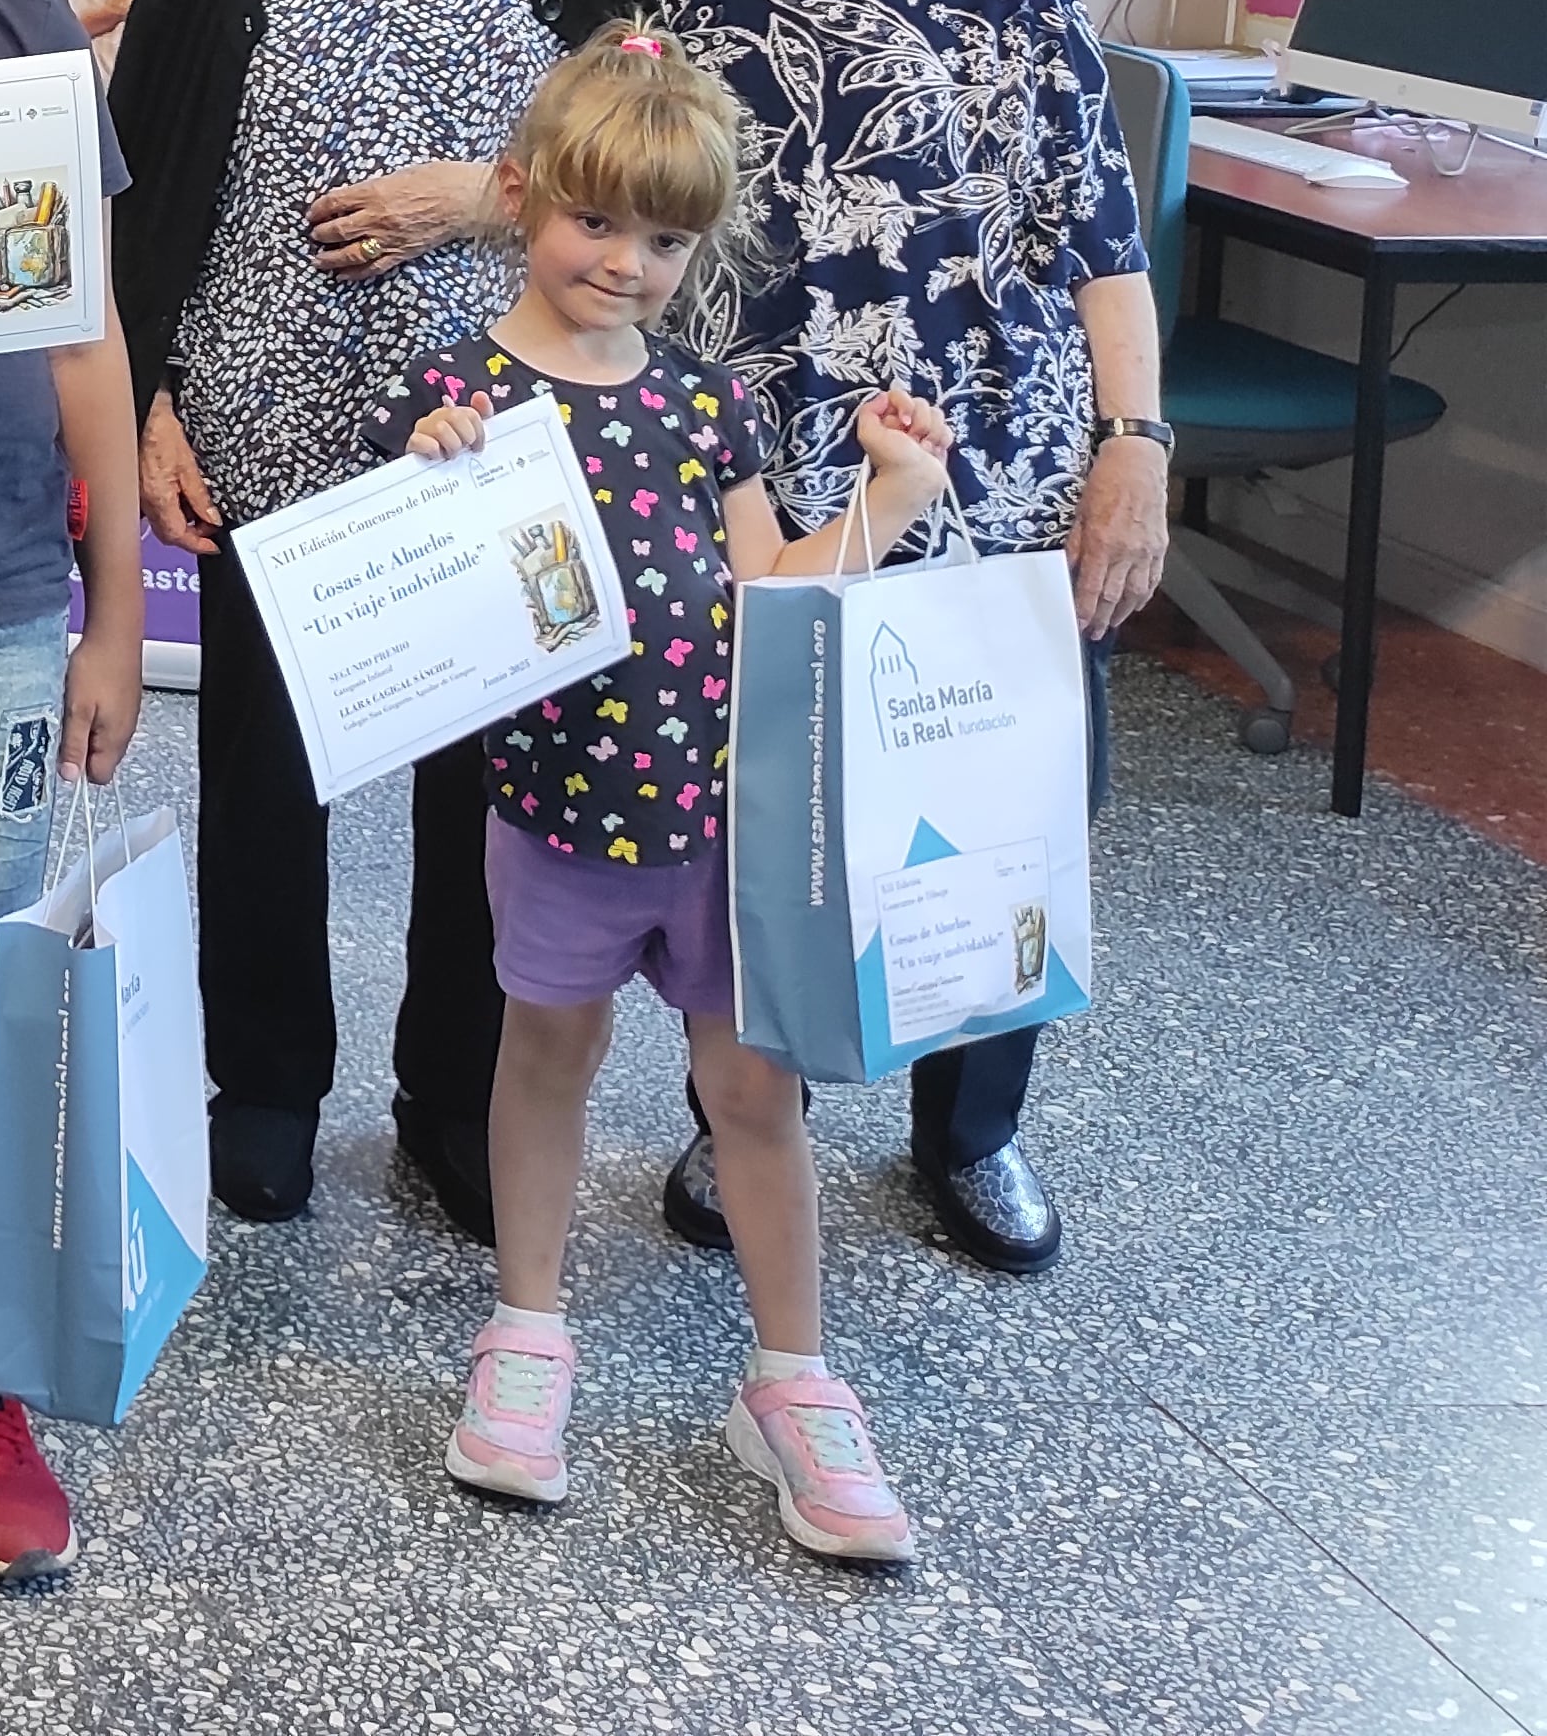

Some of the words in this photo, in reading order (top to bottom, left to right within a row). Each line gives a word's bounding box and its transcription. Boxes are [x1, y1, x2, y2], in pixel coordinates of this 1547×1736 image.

[271, 547, 297, 569] XII
[298, 530, 347, 556] Edición
[347, 504, 403, 535] Concurso
[405, 494, 419, 511] de
[419, 477, 460, 503] Dibujo
[313, 571, 362, 603] Cosas
[365, 561, 385, 581] de
[391, 531, 456, 570] Abuelos
[344, 594, 387, 618] viaje
[887, 691, 936, 720] Santa
[938, 680, 994, 709] María
[893, 727, 910, 749] la
[912, 716, 954, 746] Real
[957, 712, 1016, 736] fundación
